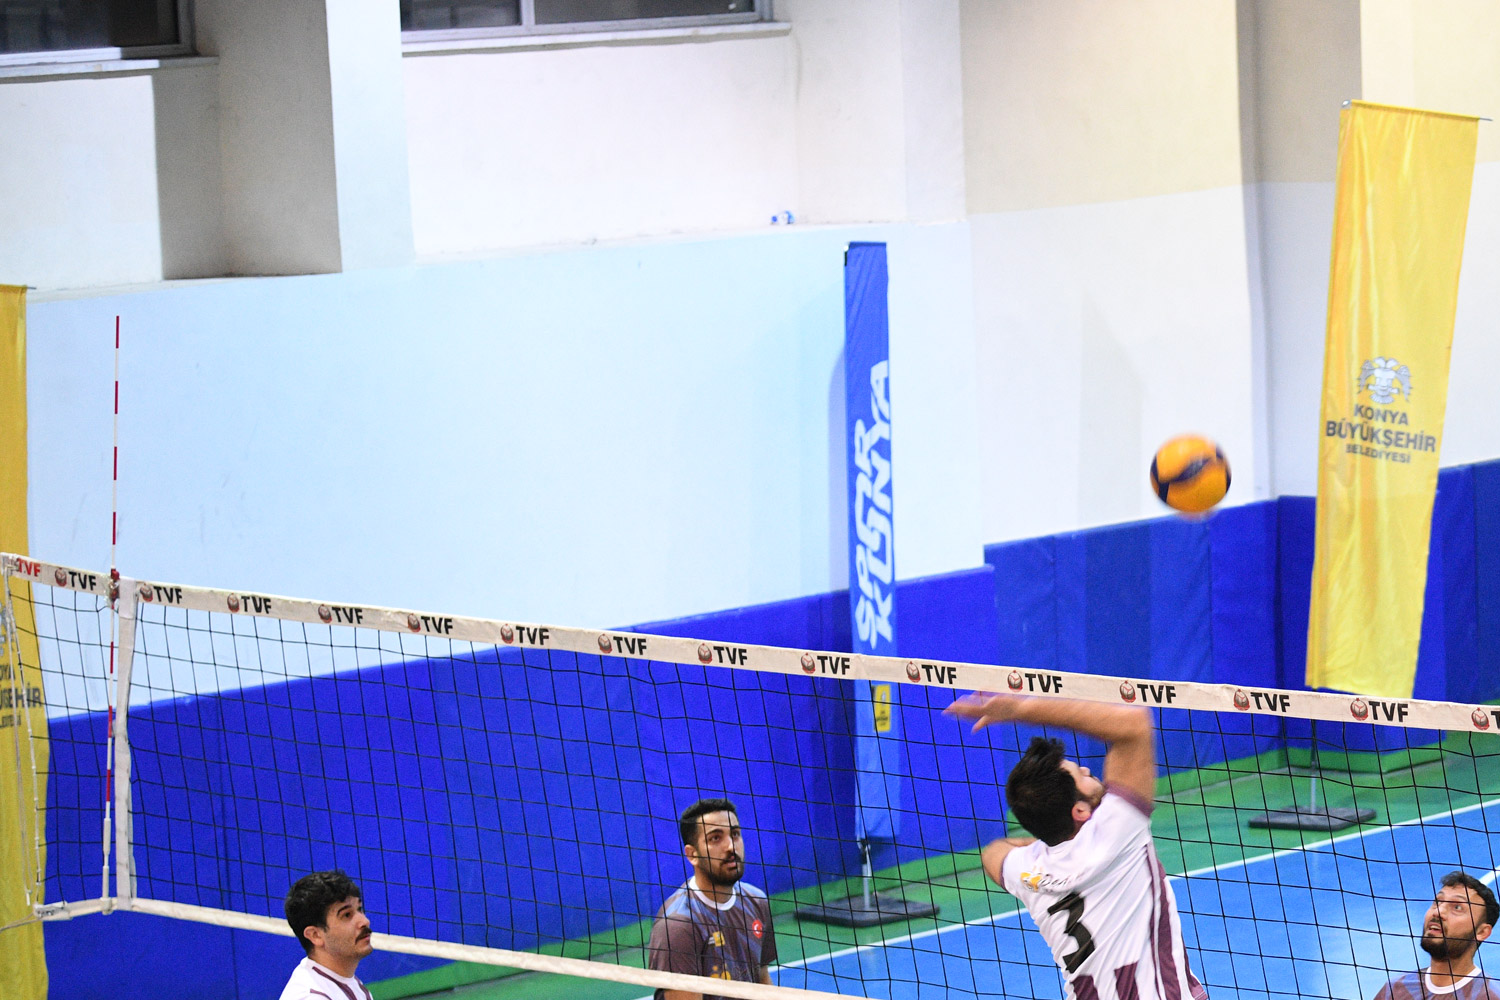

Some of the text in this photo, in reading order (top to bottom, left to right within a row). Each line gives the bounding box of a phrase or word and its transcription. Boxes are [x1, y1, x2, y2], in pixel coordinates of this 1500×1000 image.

[1353, 403, 1409, 426] KONYA
[1325, 417, 1437, 453] BÜYÜKŞEHİR
[1345, 443, 1412, 464] BELEDİYESİ
[854, 418, 880, 650] SPOR
[69, 570, 96, 591] TVF
[153, 586, 182, 605] TVF
[241, 595, 272, 615] TVF
[332, 606, 363, 625] TVF
[420, 615, 453, 634] TVF
[516, 626, 549, 645] TVF
[613, 636, 647, 655] TVF
[713, 646, 747, 666] TVF
[817, 655, 850, 675] TVF
[922, 664, 957, 685] TVF
[1025, 673, 1063, 694] TVF
[1137, 684, 1177, 704] TVF
[1251, 691, 1290, 713] TVF
[1369, 700, 1409, 723] TVF
[1047, 891, 1096, 975] 3
